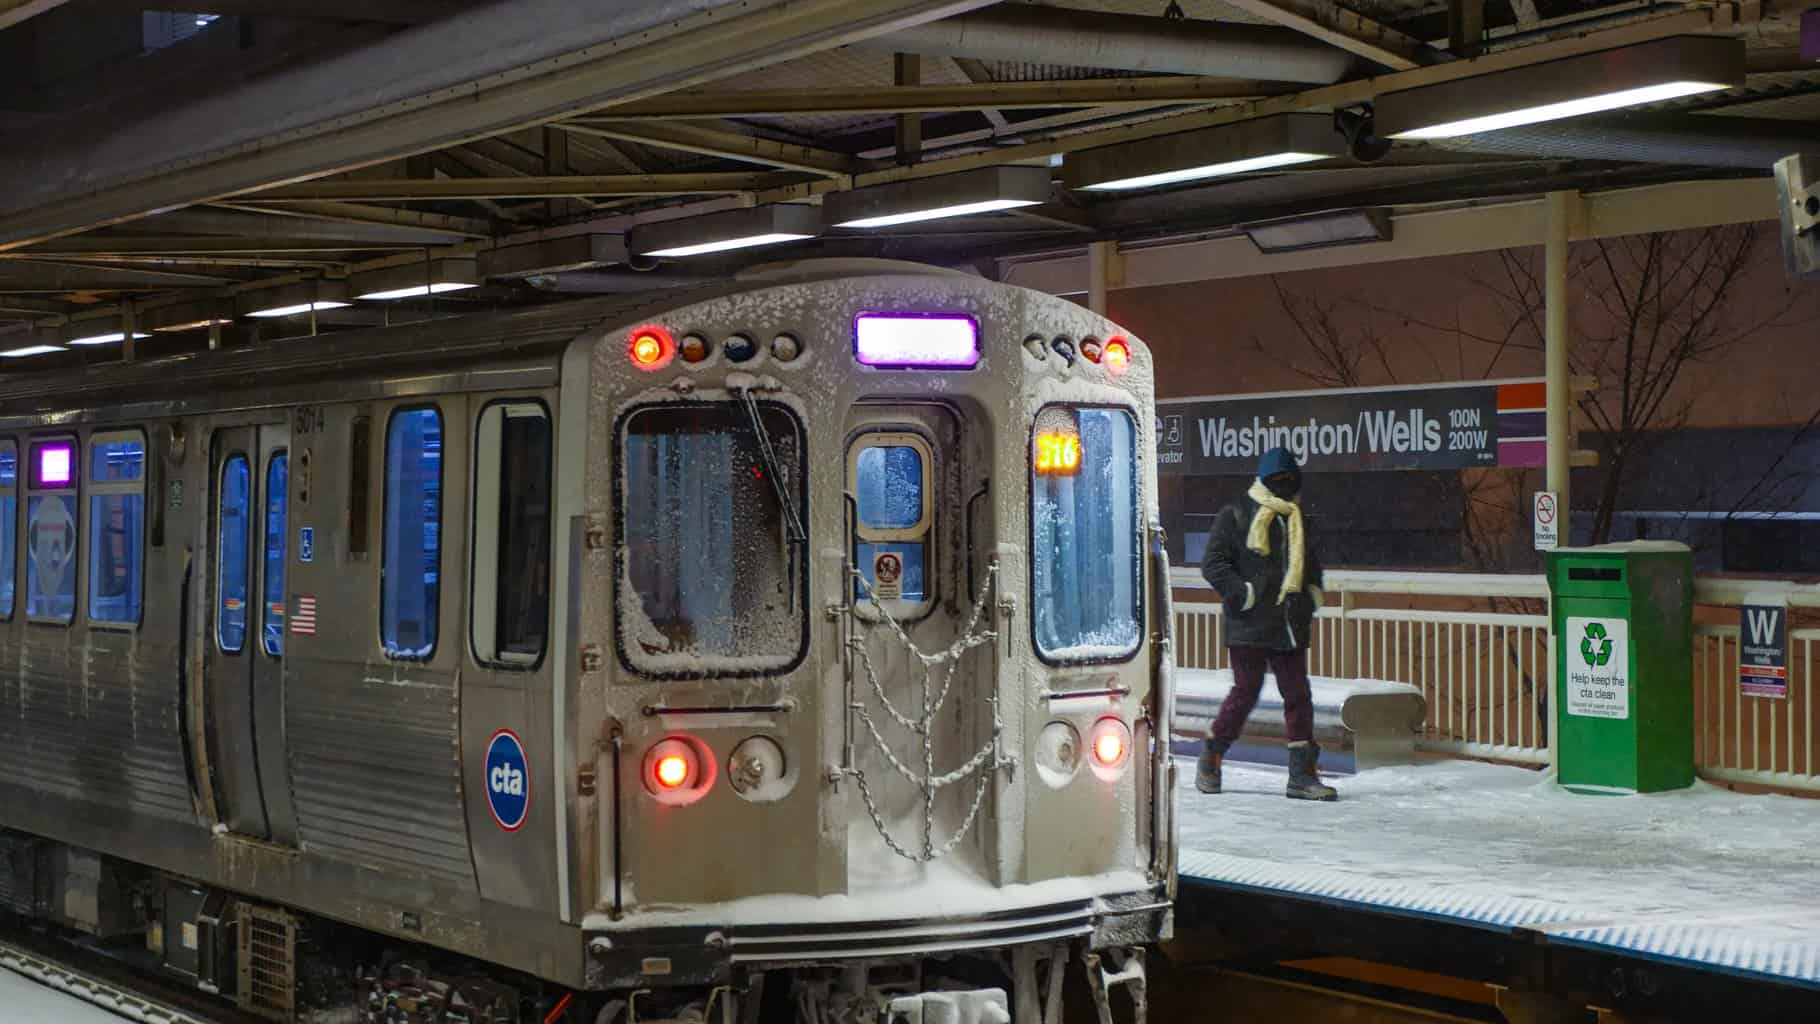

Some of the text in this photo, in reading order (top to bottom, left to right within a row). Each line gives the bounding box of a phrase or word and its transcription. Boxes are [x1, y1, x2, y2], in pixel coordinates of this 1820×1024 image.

[1448, 408, 1480, 428] 100N
[1198, 408, 1441, 466] Washington/Wells
[1448, 430, 1487, 450] 200W
[1747, 608, 1778, 645] W
[1571, 671, 1625, 688] Help keep the
[1580, 688, 1616, 700] cta clean
[491, 762, 523, 796] cta
